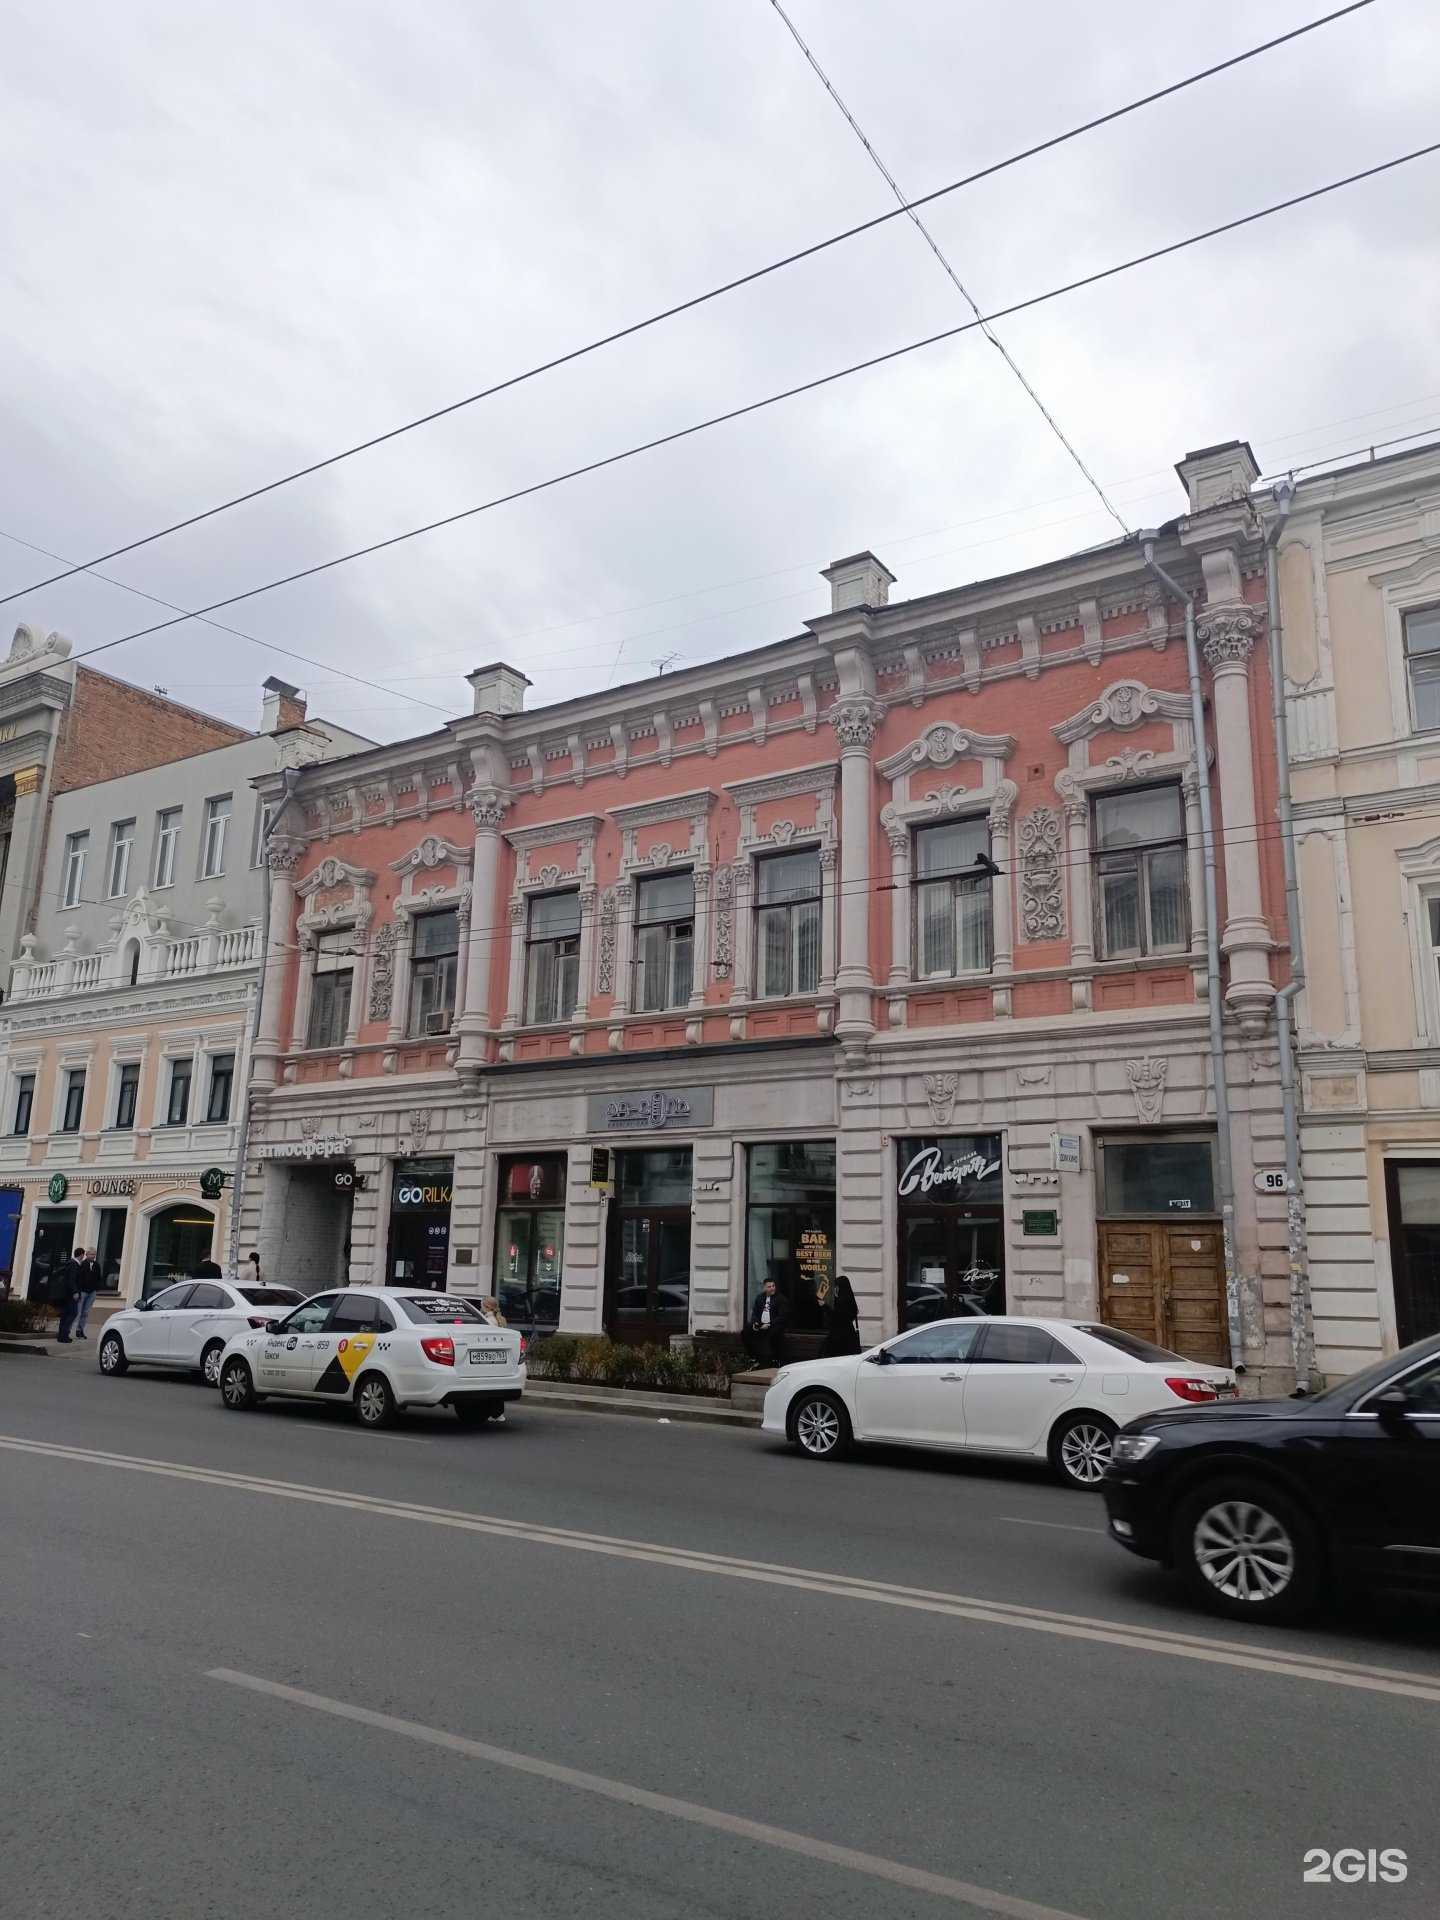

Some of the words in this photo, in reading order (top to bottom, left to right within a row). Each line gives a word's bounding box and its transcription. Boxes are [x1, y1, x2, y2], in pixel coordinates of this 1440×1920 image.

[335, 1173, 353, 1186] GO
[1266, 1174, 1284, 1188] 96
[801, 1233, 827, 1244] BAR
